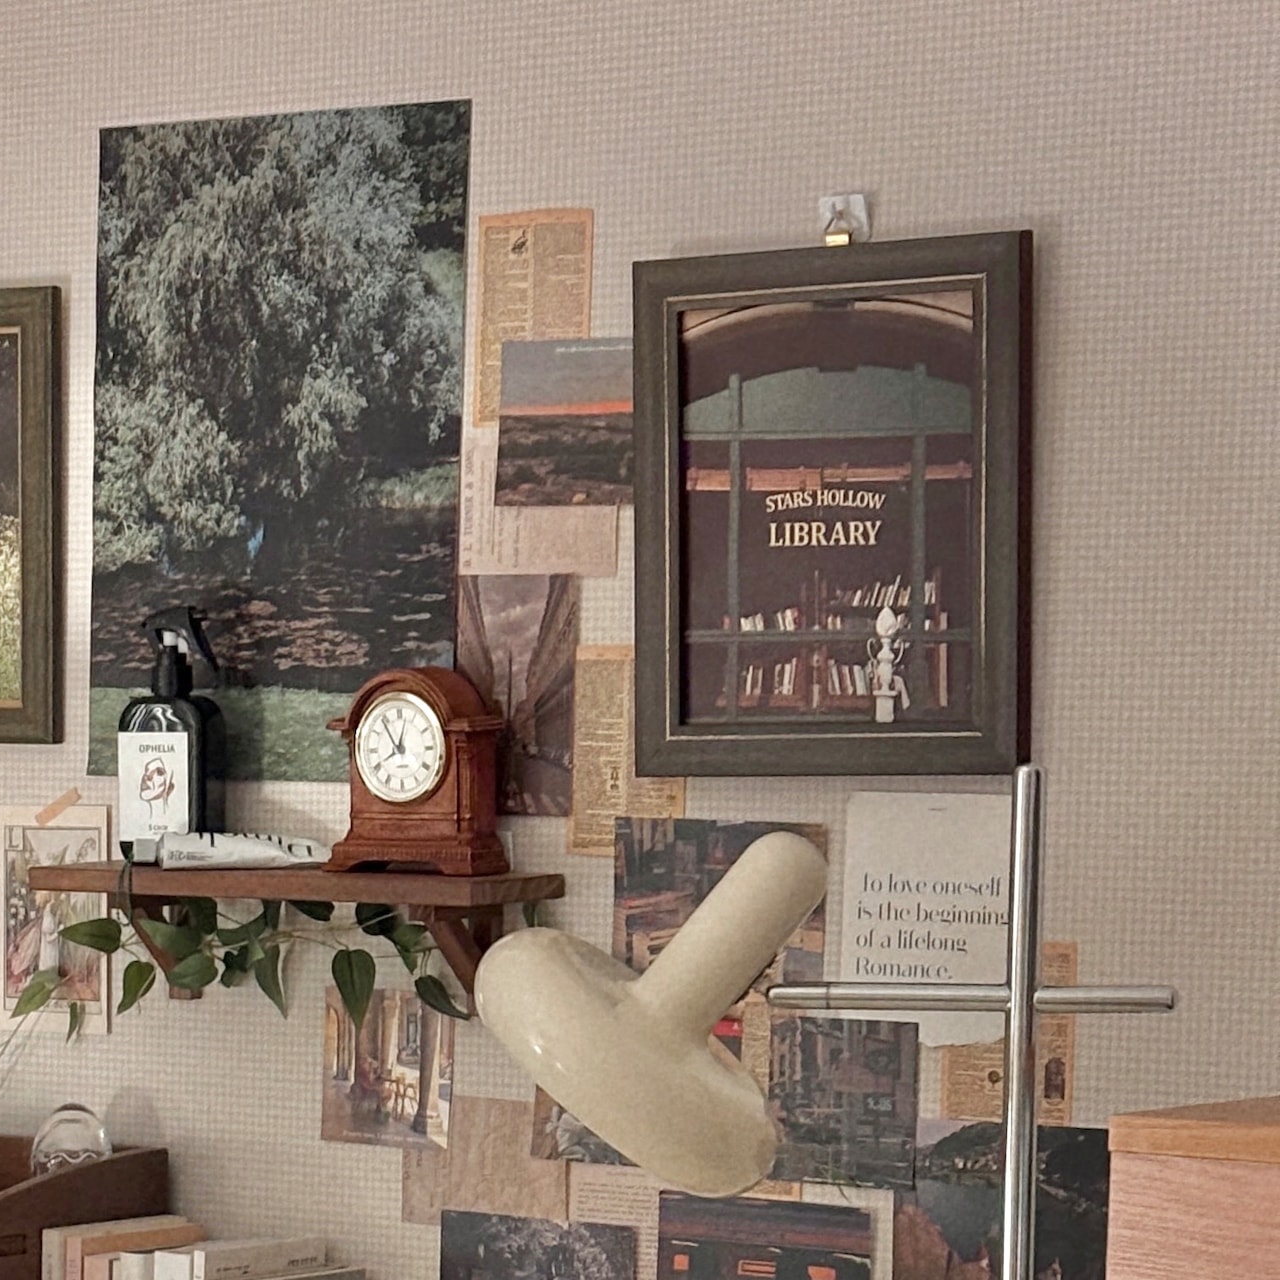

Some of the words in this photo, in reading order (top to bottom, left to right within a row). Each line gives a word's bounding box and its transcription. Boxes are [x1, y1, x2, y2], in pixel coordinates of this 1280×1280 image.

[765, 490, 813, 513] STARS
[816, 489, 886, 509] HOLLOW
[769, 520, 882, 547] LIBRARY
[139, 743, 176, 754] OPHELIA
[888, 873, 927, 894] love
[932, 876, 1003, 897] oneself
[857, 900, 872, 920] is
[879, 901, 911, 921] the
[856, 928, 875, 948] of
[880, 935, 891, 948] a
[897, 929, 968, 953] lifelong
[856, 956, 953, 980] Romance.
